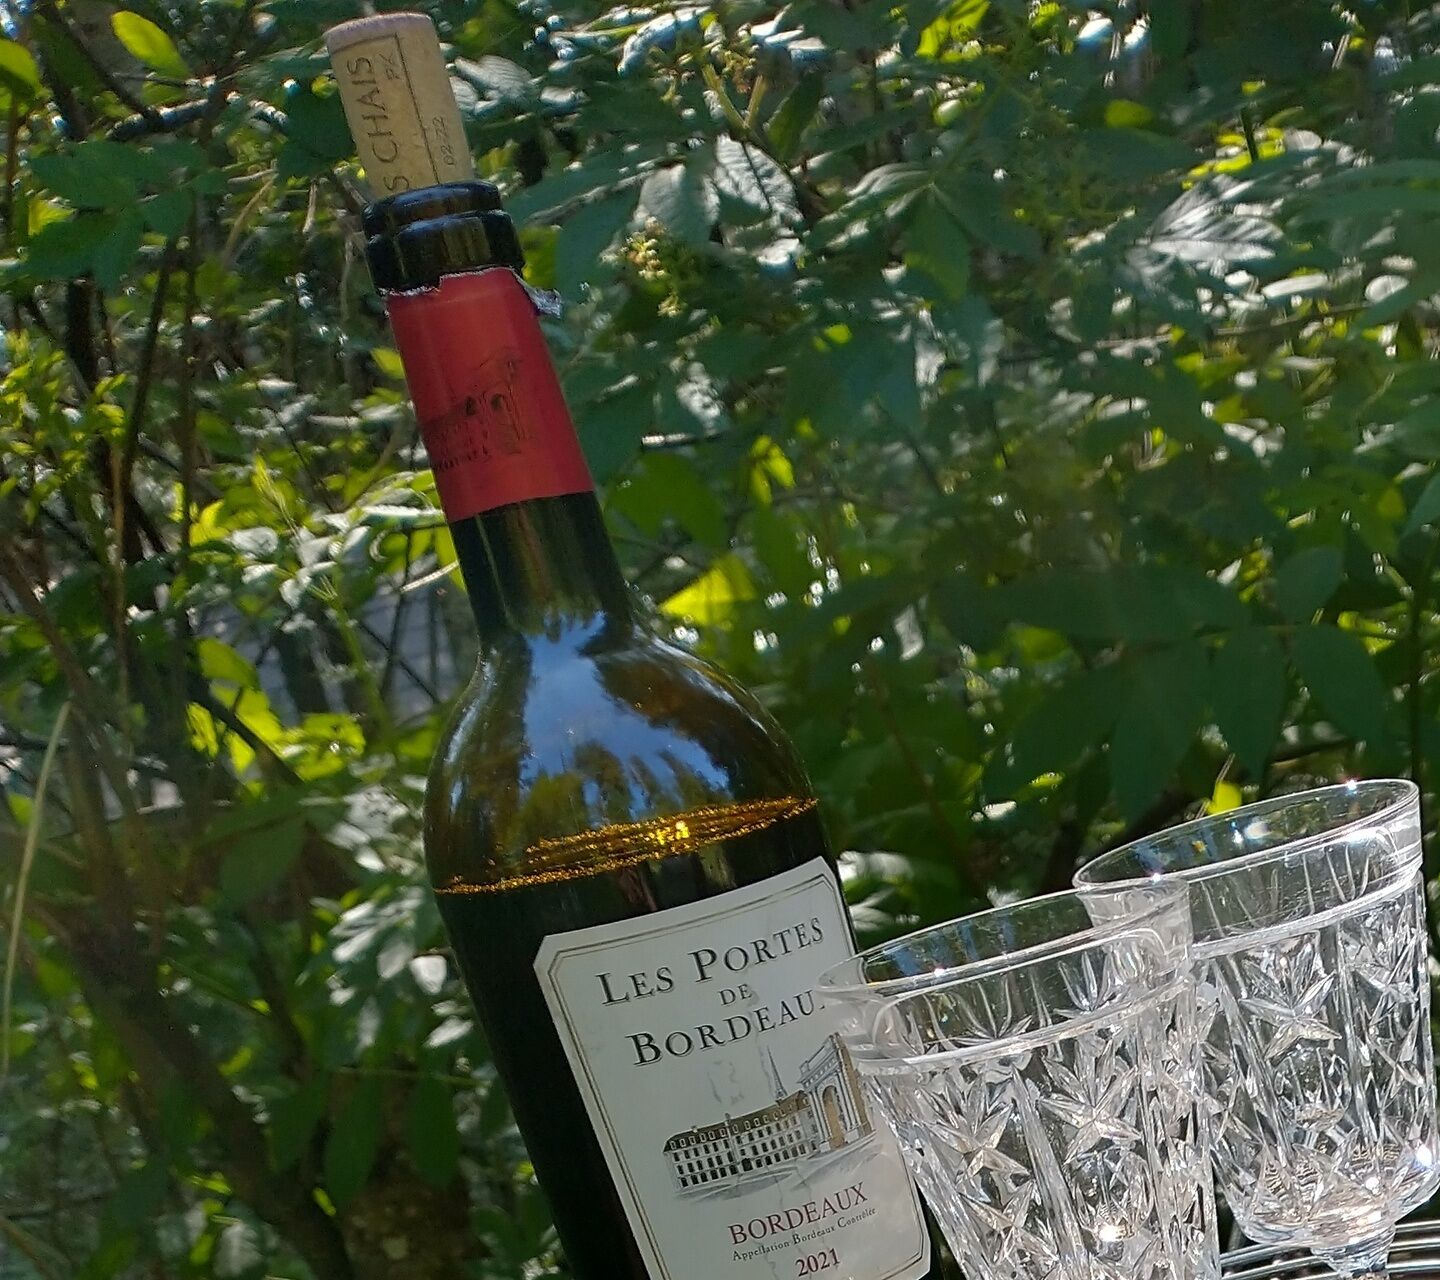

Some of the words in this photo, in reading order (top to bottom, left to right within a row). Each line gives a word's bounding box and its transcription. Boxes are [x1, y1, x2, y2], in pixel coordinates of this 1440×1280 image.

[346, 56, 399, 163] CHAIS
[596, 966, 675, 1007] LES
[688, 917, 824, 983] PORTES
[718, 983, 753, 1006] DE
[625, 989, 825, 1066] BORDEAU
[728, 1181, 868, 1245] BORDEAUX
[732, 1240, 790, 1262] Appellation
[791, 1226, 836, 1245] Bordeaux
[795, 1248, 840, 1277] 2021
